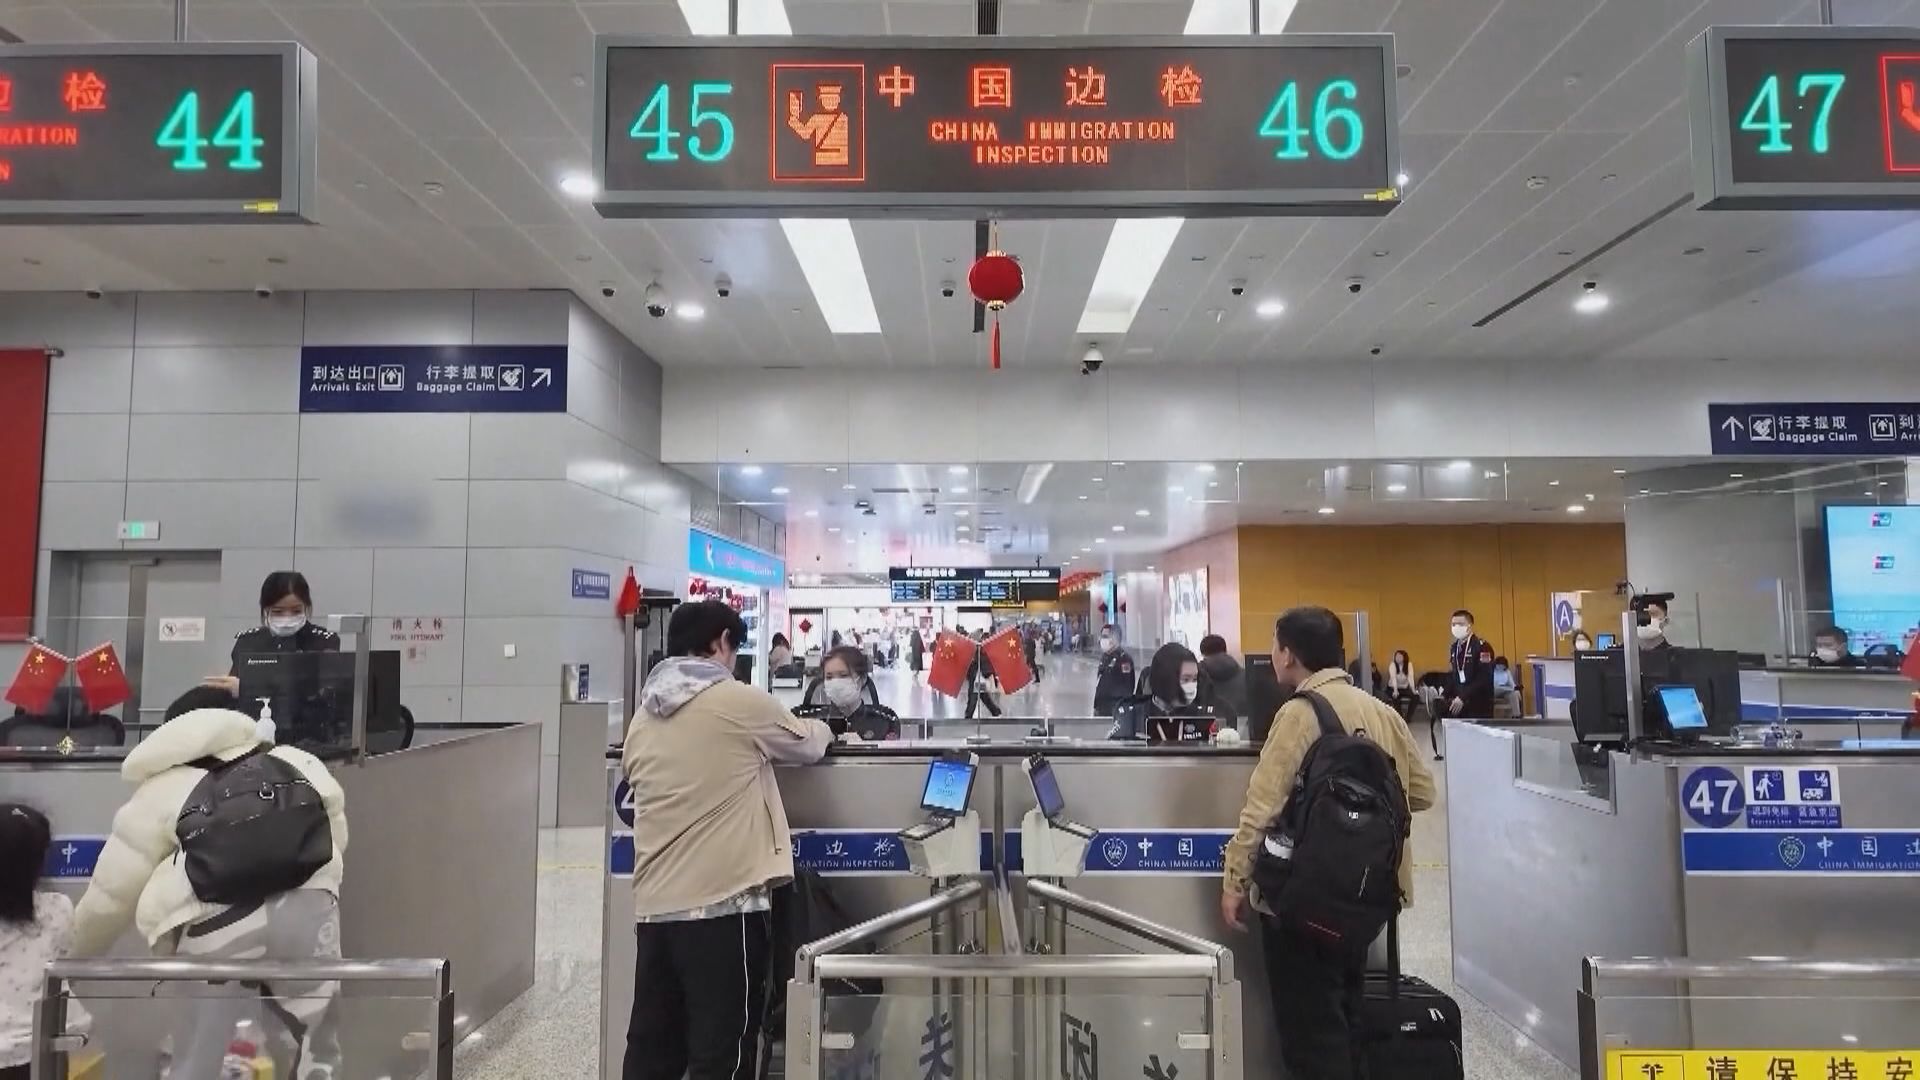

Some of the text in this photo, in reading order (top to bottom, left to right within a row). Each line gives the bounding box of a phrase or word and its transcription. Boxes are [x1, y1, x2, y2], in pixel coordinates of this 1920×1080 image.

[878, 66, 1202, 107] 中国边检
[630, 84, 734, 160] 45
[1259, 80, 1363, 159] 46
[1741, 75, 1845, 153] 47
[156, 91, 264, 169] 44
[931, 122, 1174, 140] CHINA IMMIGRATION
[976, 146, 1108, 164] INSPECTION
[313, 365, 376, 381] 到达出口
[426, 365, 495, 380] 行李提取
[310, 382, 375, 392] Arrivals Exit
[417, 382, 495, 394] Baggage Claim
[1778, 415, 1847, 430] 行李提取
[1899, 414, 1920, 429] 到
[1779, 431, 1858, 443] Baggage Claim
[1560, 604, 1571, 627] A
[1690, 780, 1738, 815] 47
[61, 842, 78, 864] 中
[1138, 837, 1225, 857] 中国
[60, 867, 90, 876] CHINA
[843, 860, 895, 868] INSPECTION
[1139, 860, 1167, 868] CHINA
[1819, 861, 1849, 870] CHINA
